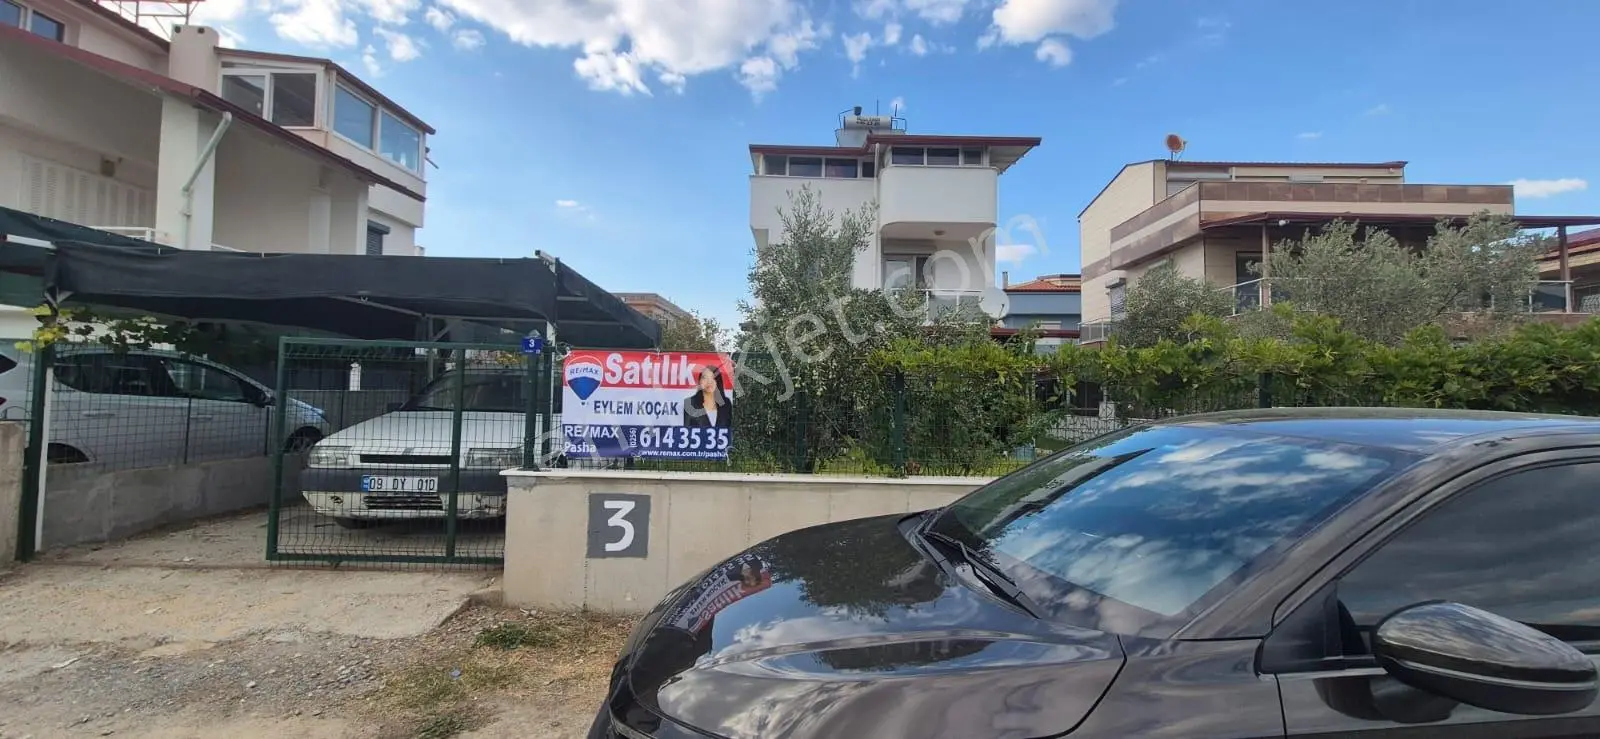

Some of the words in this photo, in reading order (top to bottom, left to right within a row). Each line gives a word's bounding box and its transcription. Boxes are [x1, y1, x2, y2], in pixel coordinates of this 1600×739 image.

[528, 338, 535, 348] 3
[569, 365, 600, 375] RE/MAX
[604, 352, 697, 386] Satılık
[593, 400, 633, 415] EYLEM
[636, 400, 679, 420] KOÇAK
[564, 426, 619, 439] RE/MAX
[639, 427, 675, 448] 614
[678, 428, 701, 449] 35
[705, 428, 729, 449] 35
[563, 441, 597, 453] Pasha
[369, 478, 383, 490] 09
[392, 478, 406, 490] DY
[417, 478, 435, 491] 010
[604, 500, 636, 552] 3
